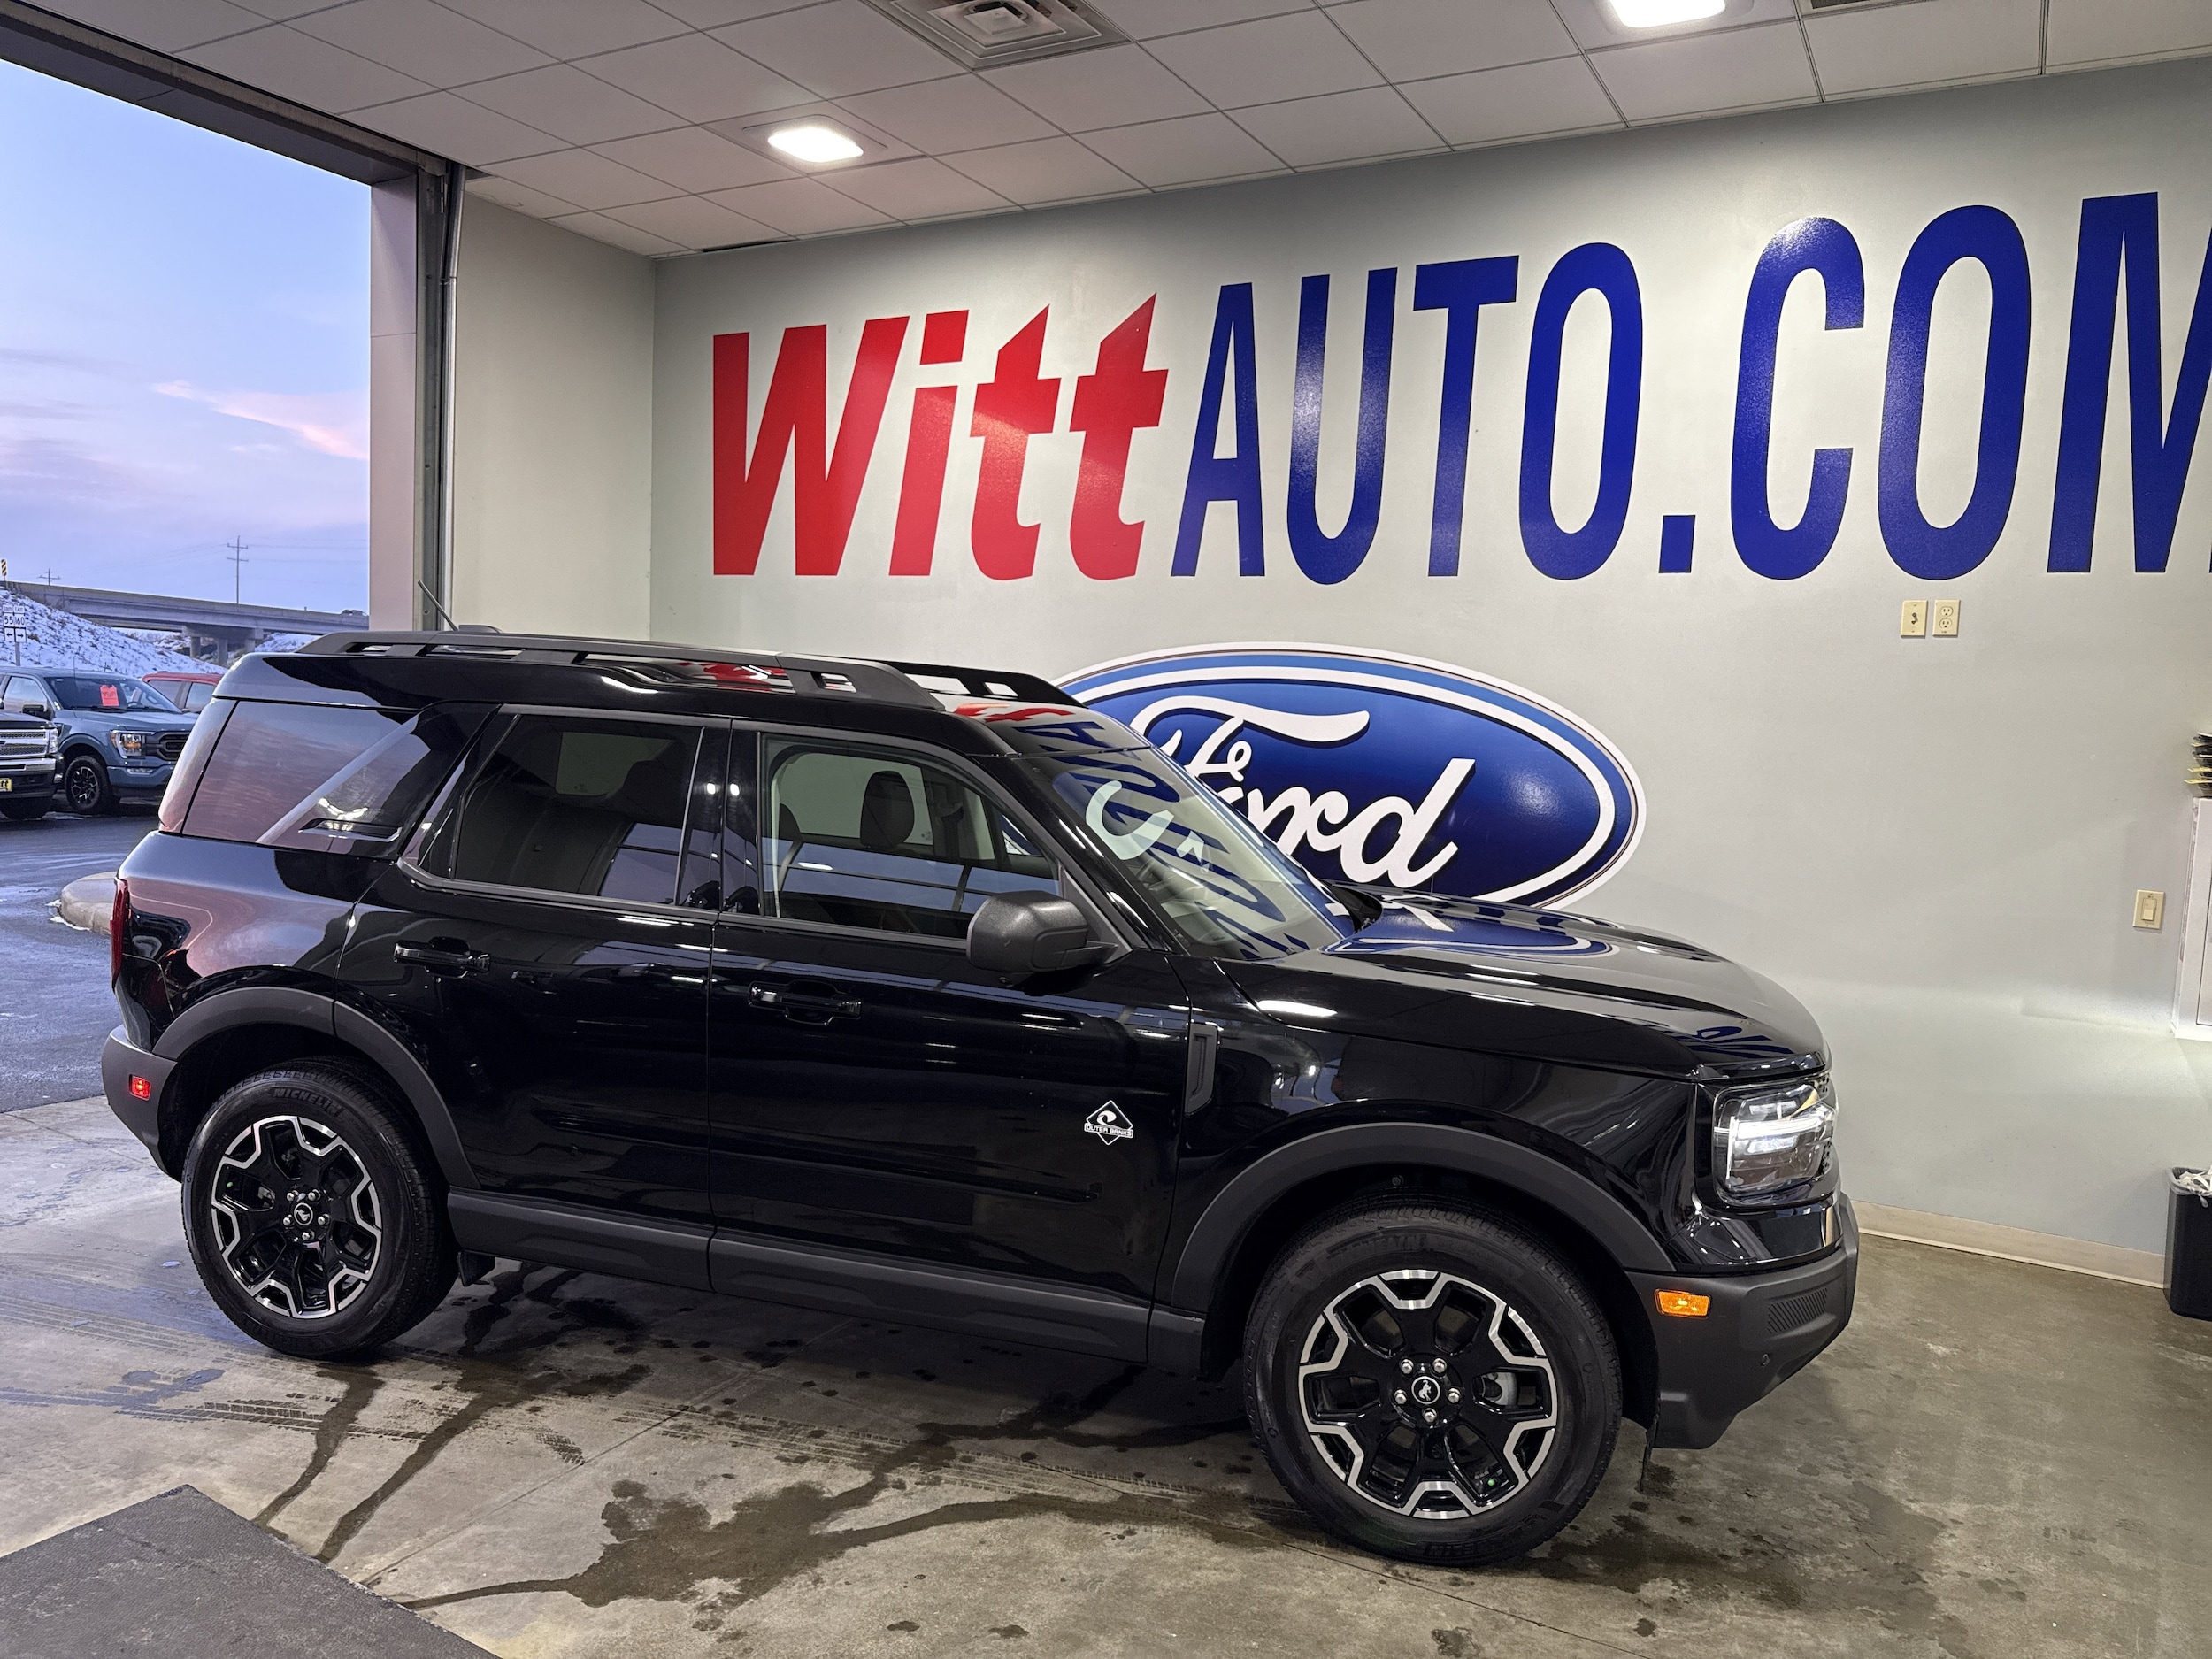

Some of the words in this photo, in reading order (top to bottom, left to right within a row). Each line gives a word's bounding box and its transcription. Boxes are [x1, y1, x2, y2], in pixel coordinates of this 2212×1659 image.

[4, 616, 13, 625] 55
[273, 1087, 345, 1118] MICHELIN
[1109, 1127, 1133, 1137] BANKS
